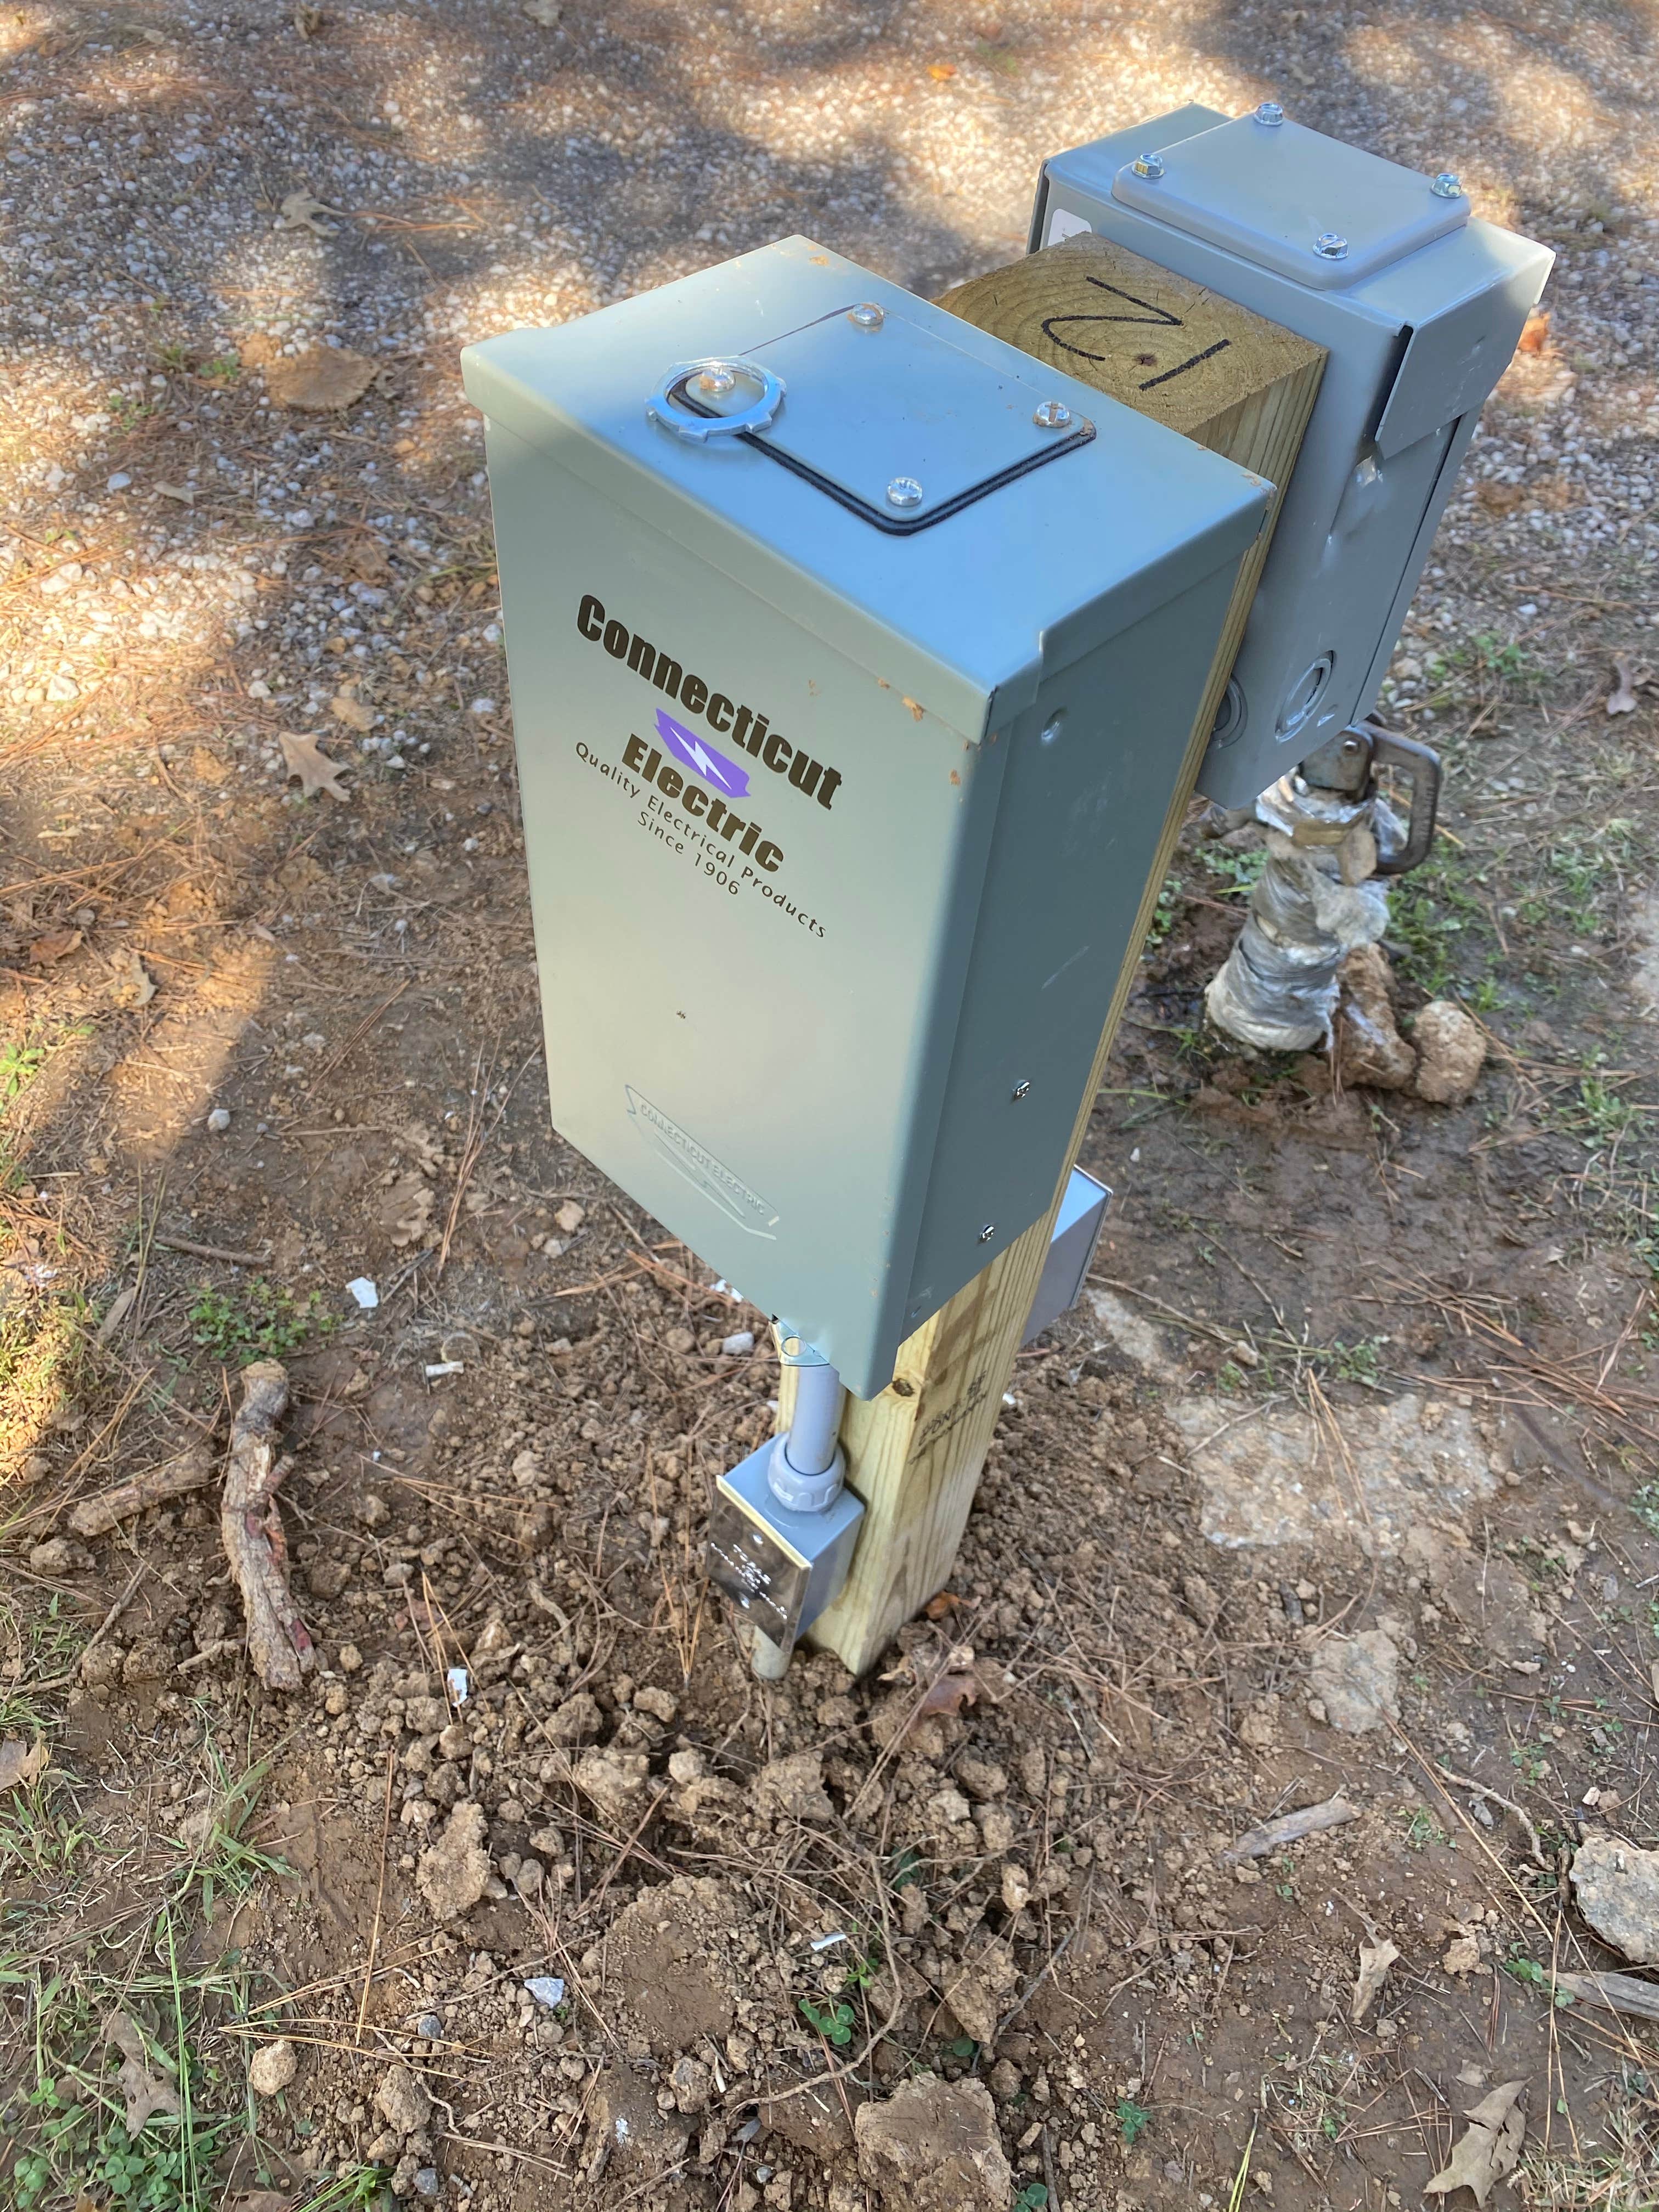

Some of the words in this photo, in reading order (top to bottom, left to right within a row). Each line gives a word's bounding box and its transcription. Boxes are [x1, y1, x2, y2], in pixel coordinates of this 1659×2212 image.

[577, 595, 842, 810] Connecticut
[575, 742, 640, 798] Quality
[647, 795, 735, 868] Electrical
[741, 866, 826, 938] Products
[622, 733, 784, 872] Electric
[637, 811, 684, 854] Since
[694, 853, 740, 895] 1906
[640, 1104, 711, 1169] CONNECTICUT
[713, 1165, 764, 1215] ELECTRIC
